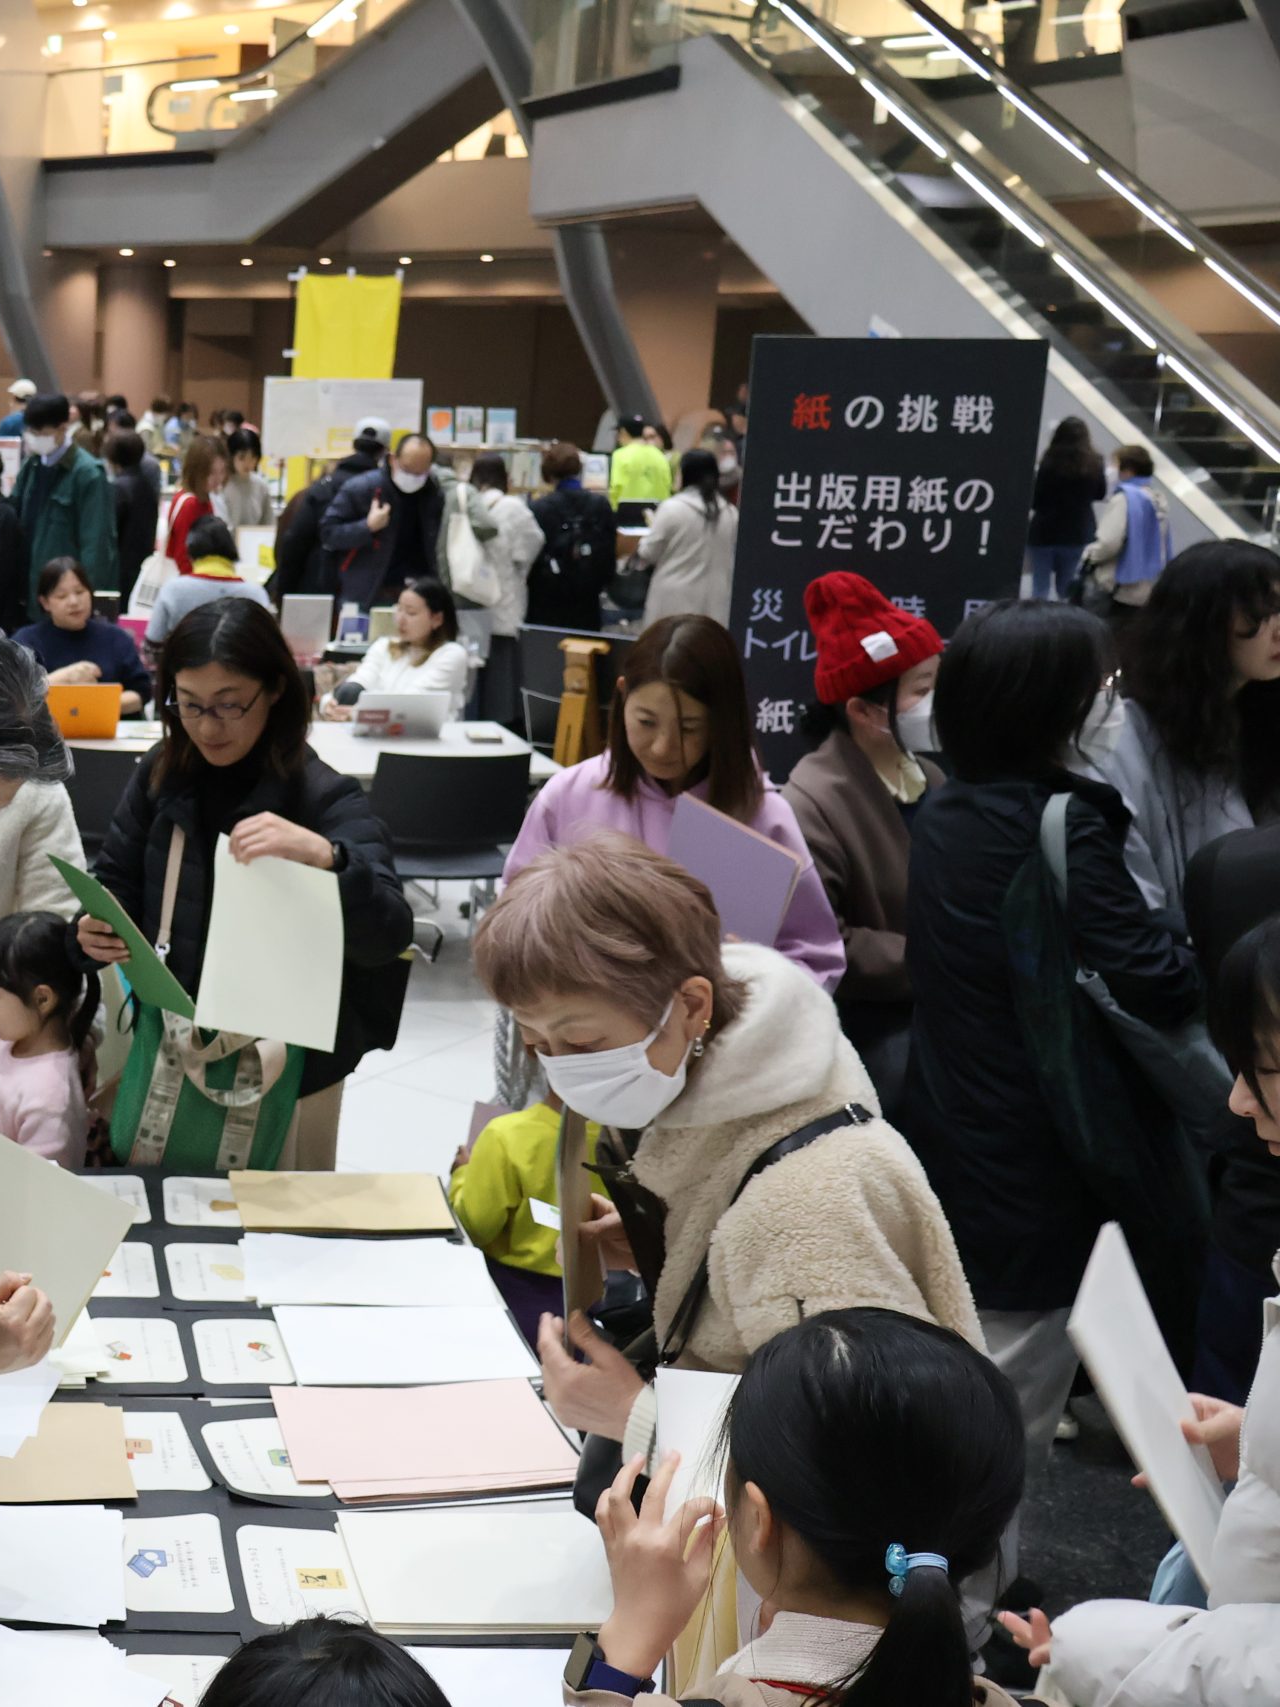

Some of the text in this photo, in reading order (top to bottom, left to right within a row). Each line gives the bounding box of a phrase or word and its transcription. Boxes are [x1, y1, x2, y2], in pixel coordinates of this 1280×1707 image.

[791, 394, 995, 434] 紙の挑戦
[773, 471, 995, 514] 出版用紙の
[755, 697, 808, 734] 紙
